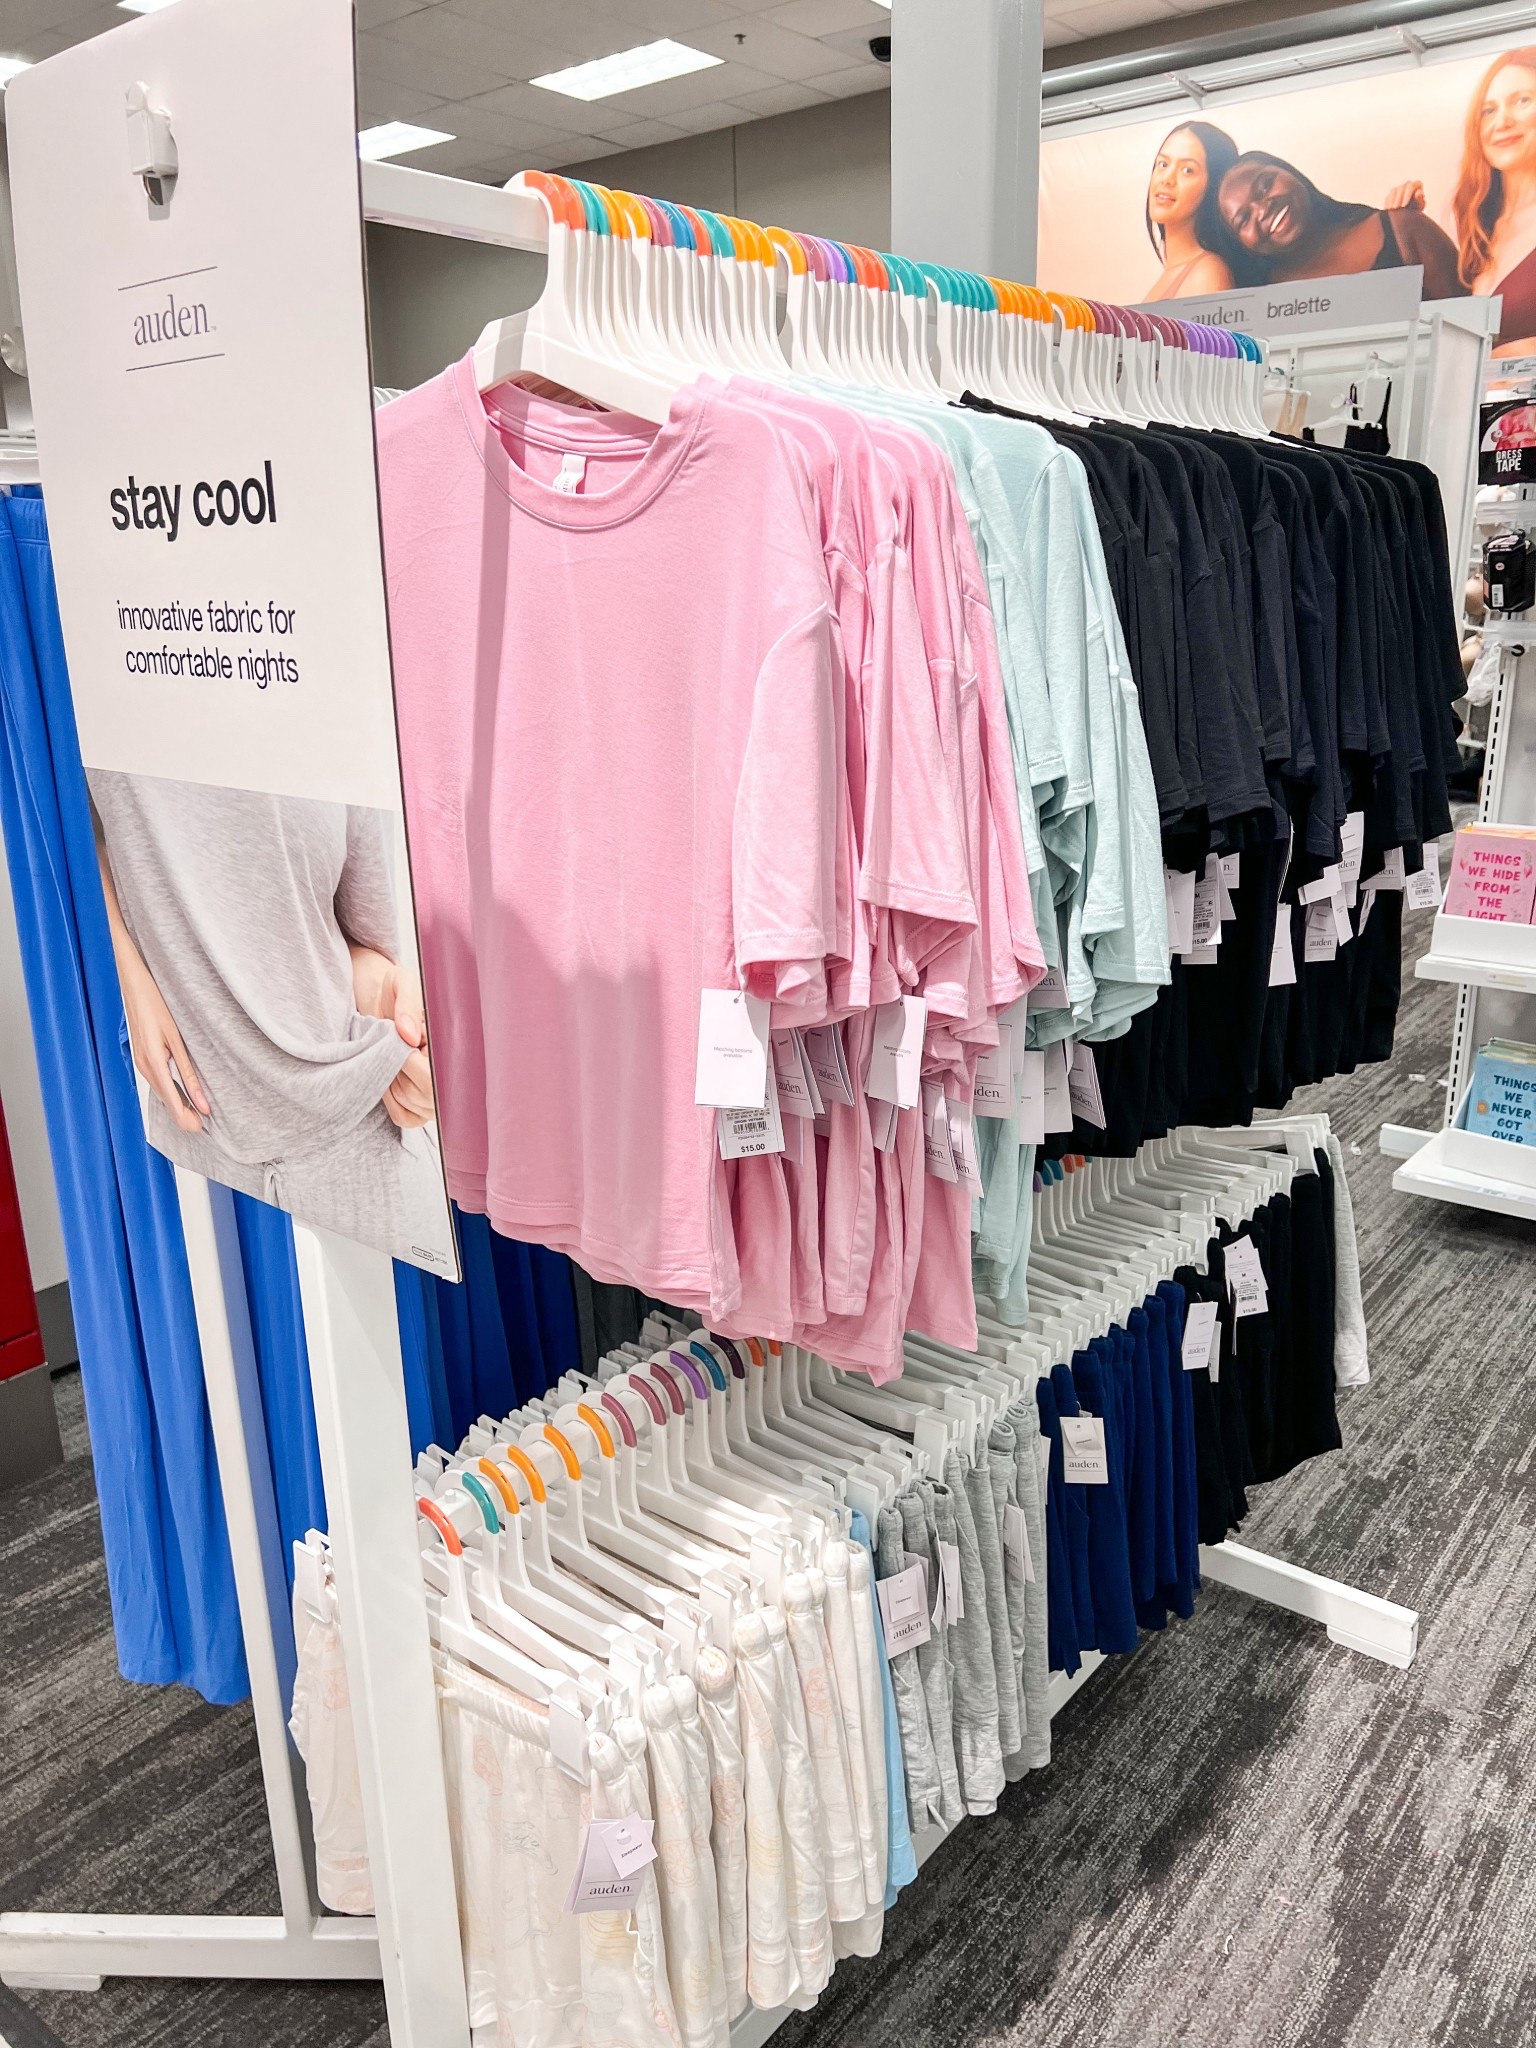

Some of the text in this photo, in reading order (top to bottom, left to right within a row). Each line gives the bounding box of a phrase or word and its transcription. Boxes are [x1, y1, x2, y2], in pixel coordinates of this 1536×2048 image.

[1267, 296, 1331, 319] bralette
[133, 294, 210, 346] auden
[1496, 449, 1522, 461] DRESS
[1496, 457, 1522, 473] TAPE
[110, 460, 277, 542] stay cool
[117, 600, 296, 634] innovative fabric for
[125, 645, 299, 690] comfortable nights
[1473, 851, 1522, 867] THINGS
[1468, 865, 1521, 881] WE HIDE
[1474, 881, 1511, 895] FROM
[1477, 896, 1503, 909] THE
[1193, 937, 1208, 945] 15.00
[777, 1079, 802, 1094] auden
[1493, 1074, 1536, 1093] THINGS
[1504, 1090, 1524, 1104] WE
[1491, 1102, 1532, 1120] NEVER
[1497, 1117, 1523, 1131] GOT
[740, 1143, 766, 1153] $15.00
[1068, 1460, 1099, 1469] auden
[892, 1620, 923, 1640] auden
[589, 1883, 631, 1896] auden
